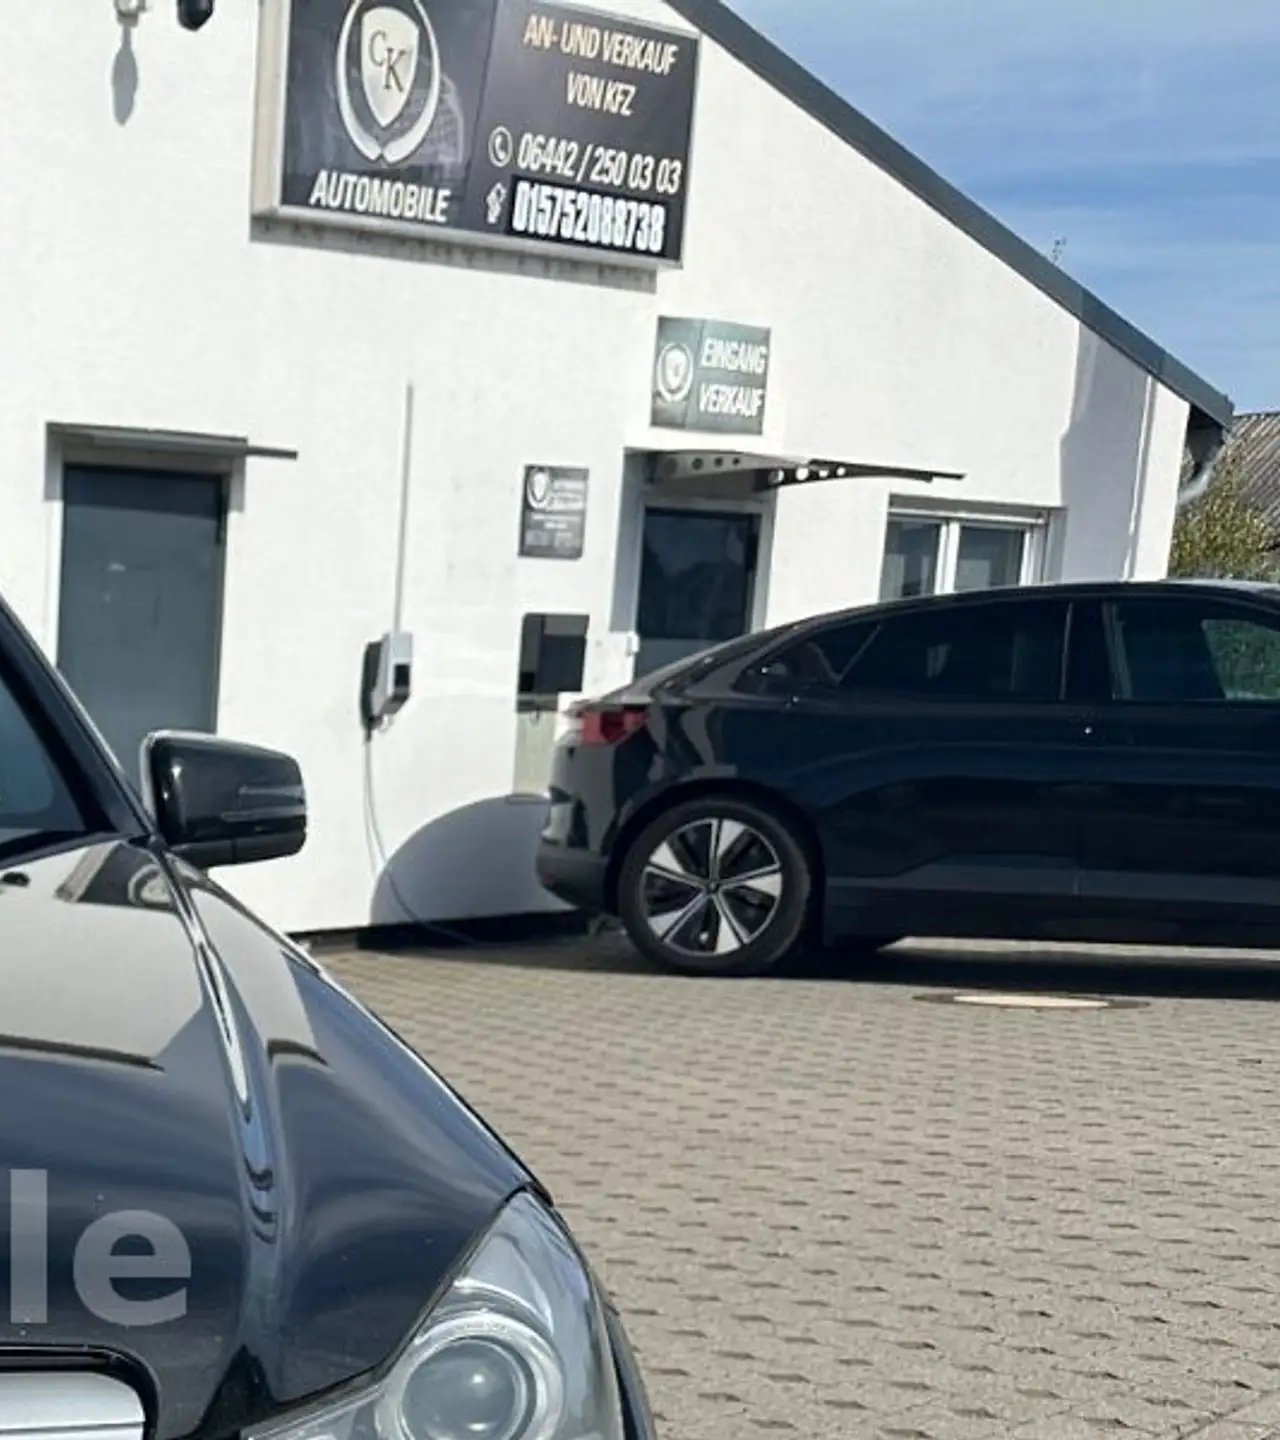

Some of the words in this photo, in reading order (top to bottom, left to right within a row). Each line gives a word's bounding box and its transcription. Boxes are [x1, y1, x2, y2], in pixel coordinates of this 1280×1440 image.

[369, 29, 406, 93] CK
[523, 15, 559, 49] AN-
[560, 21, 600, 59] UND
[602, 29, 679, 76] VERKAUF
[566, 70, 603, 110] VON
[603, 79, 637, 116] KFZ
[517, 132, 579, 178] 06442
[590, 147, 628, 186] 250
[628, 153, 654, 191] 03
[656, 158, 682, 194] 03
[308, 168, 452, 223] AUTOMOBILE
[700, 337, 767, 374] EINGANG
[699, 382, 764, 417] VERKAUF
